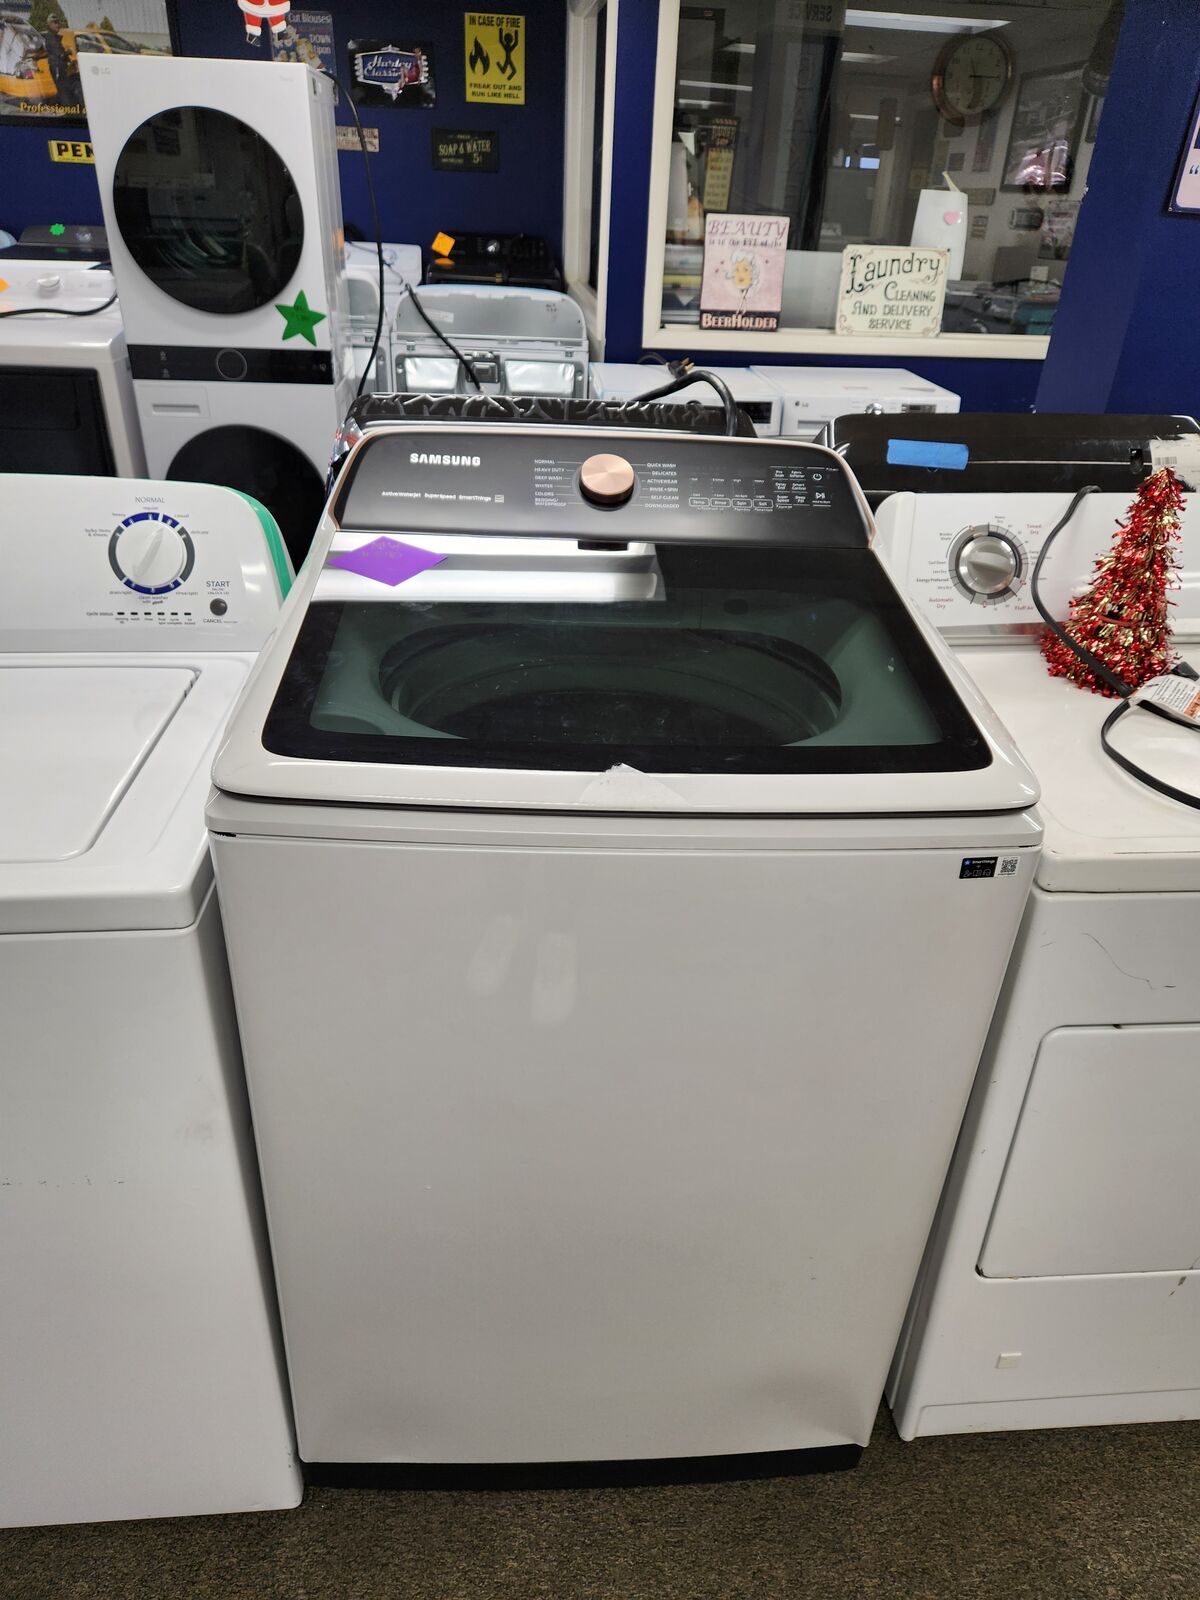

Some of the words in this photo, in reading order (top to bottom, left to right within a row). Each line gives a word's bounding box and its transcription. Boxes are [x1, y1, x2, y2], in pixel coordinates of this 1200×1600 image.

[469, 15, 476, 25] IN
[478, 16, 494, 26] CASE
[496, 17, 505, 27] OF
[506, 17, 521, 28] FIRE
[20, 102, 80, 114] Professional
[438, 143, 458, 156] SOAP
[466, 140, 491, 153] WATER
[708, 220, 788, 240] BEAUTY
[846, 252, 940, 294] Laundry
[883, 304, 933, 316] DELIVERY
[868, 318, 912, 330] SERVICE
[410, 453, 481, 466] SAMSUNG
